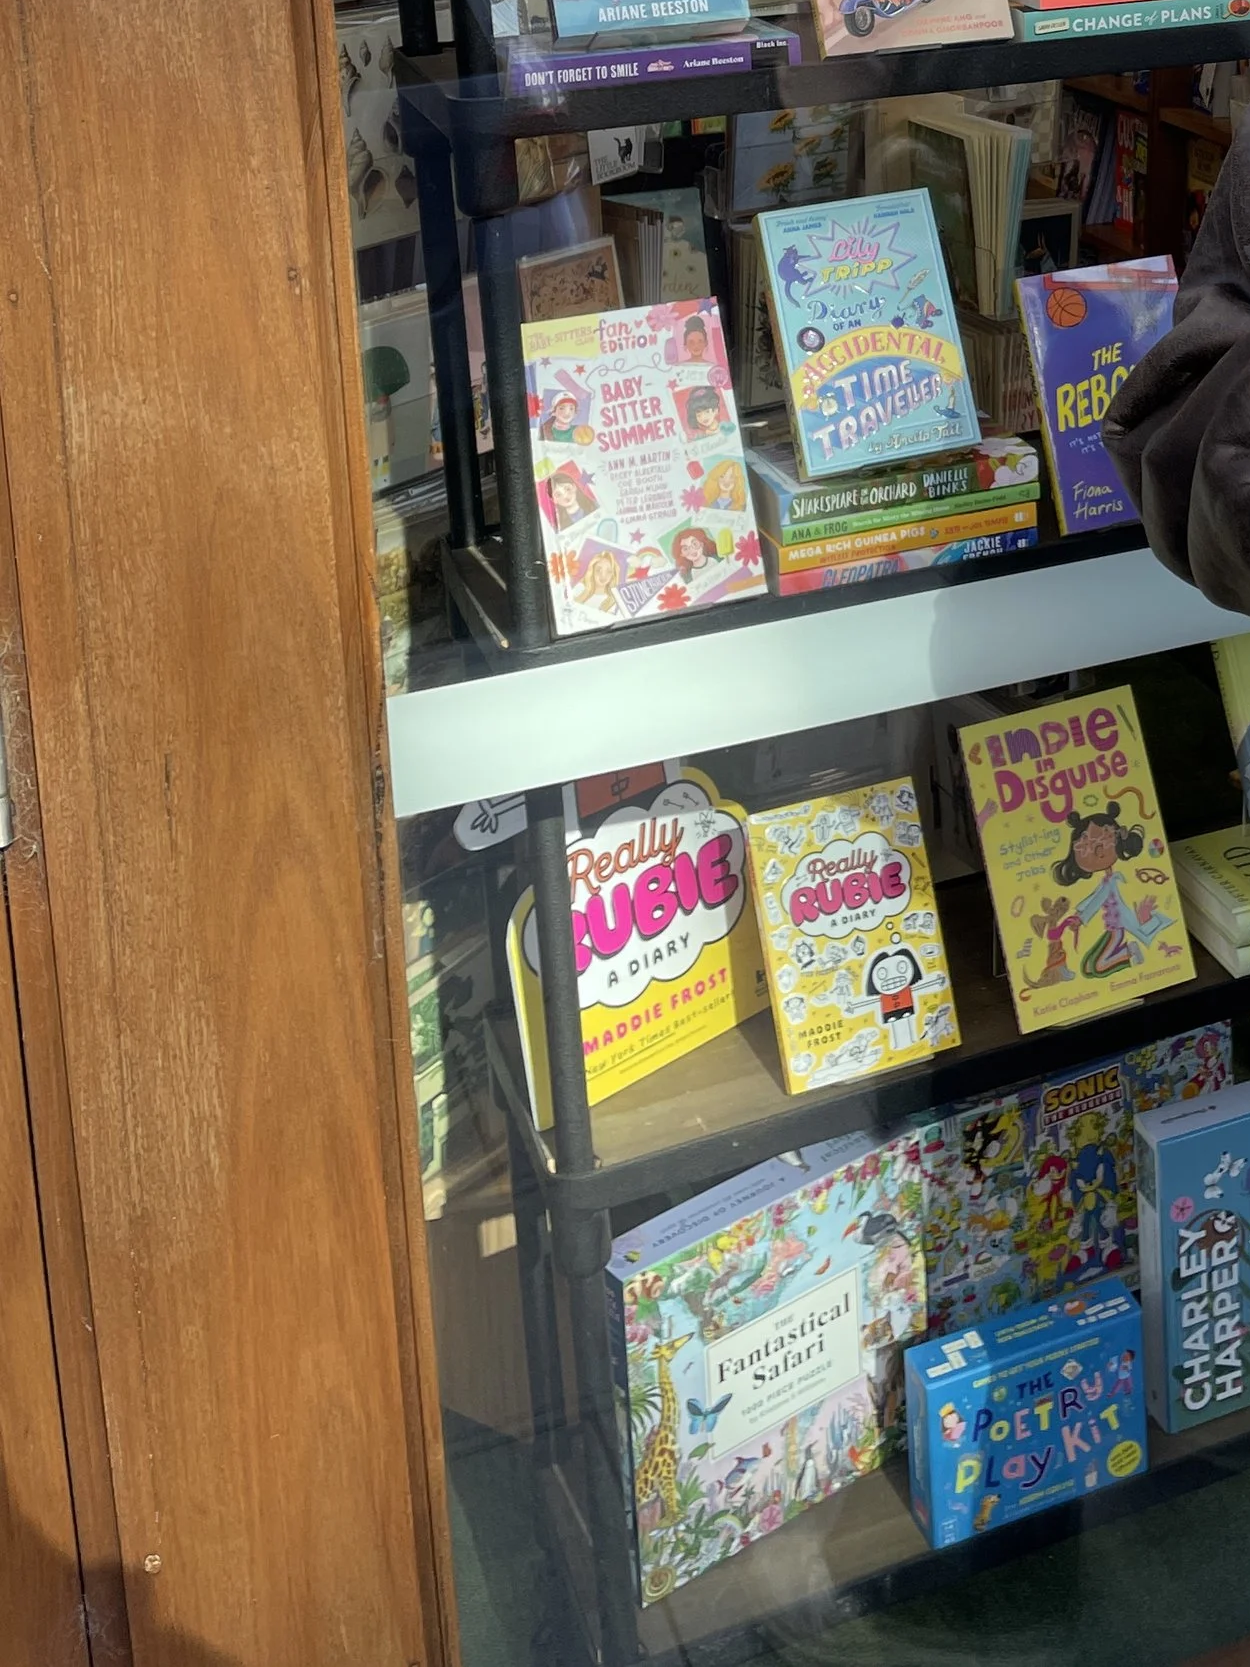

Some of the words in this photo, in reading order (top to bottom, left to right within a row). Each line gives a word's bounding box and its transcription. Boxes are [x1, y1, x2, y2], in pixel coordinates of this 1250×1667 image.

[599, 4, 647, 23] ARIANE
[1072, 13, 1142, 32] CHANGE
[1144, 11, 1157, 28] of
[1160, 6, 1212, 24] PLANS
[524, 69, 555, 87] DON'T
[558, 66, 593, 84] FORGET
[596, 66, 608, 80] TO
[610, 62, 639, 79] SMILE
[683, 58, 710, 69] Ariane
[712, 55, 744, 66] Beeston
[828, 236, 880, 264] Lily
[821, 257, 894, 282] TRIPP
[807, 294, 887, 320] Diary
[832, 321, 845, 332] OF
[847, 318, 862, 330] AN
[600, 334, 658, 354] EDITION
[802, 331, 946, 385] ACCIDENTAL
[1092, 342, 1123, 371] THE
[600, 375, 651, 404] BABY-
[833, 359, 914, 408] TIME
[600, 396, 663, 428] SITTER
[812, 372, 943, 461] TRAVELLER
[596, 416, 677, 452] SUMMER
[608, 459, 625, 471] ANN
[628, 457, 637, 468] M.
[640, 450, 671, 468] MARTIN
[922, 467, 968, 488] DANIELLE
[928, 480, 968, 499] BINKS
[1073, 481, 1112, 501] Fiona
[792, 489, 858, 519] SHAKESPEARE
[869, 482, 917, 505] ORCHARD
[1074, 499, 1123, 520] Harris
[788, 546, 822, 562] MEGA
[826, 540, 851, 554] RICH
[854, 531, 897, 549] GUINEA
[900, 526, 926, 539] PIGS
[963, 535, 1002, 553] JACKIE
[822, 559, 901, 587] CLEOPATRA
[985, 707, 1119, 770] INDIE
[1035, 757, 1056, 774] IN
[566, 816, 684, 902] Really
[808, 848, 878, 883] Really
[790, 861, 906, 928] RUBIE
[830, 918, 838, 928] A
[842, 908, 877, 924] DIARY
[608, 970, 619, 988] A
[629, 932, 690, 977] DIARY
[583, 1002, 663, 1057] MADDIE
[671, 967, 728, 1011] FROST
[798, 1020, 844, 1039] MADDIE
[806, 1032, 841, 1048] FROST
[1044, 1066, 1120, 1113] SONIC
[1178, 1228, 1213, 1411] CHARLEY
[1211, 1236, 1243, 1401] HARPER
[718, 1292, 850, 1384] Fantastical
[752, 1333, 824, 1390] Safari
[1015, 1371, 1055, 1399] THE
[971, 1371, 1104, 1443] POETRY
